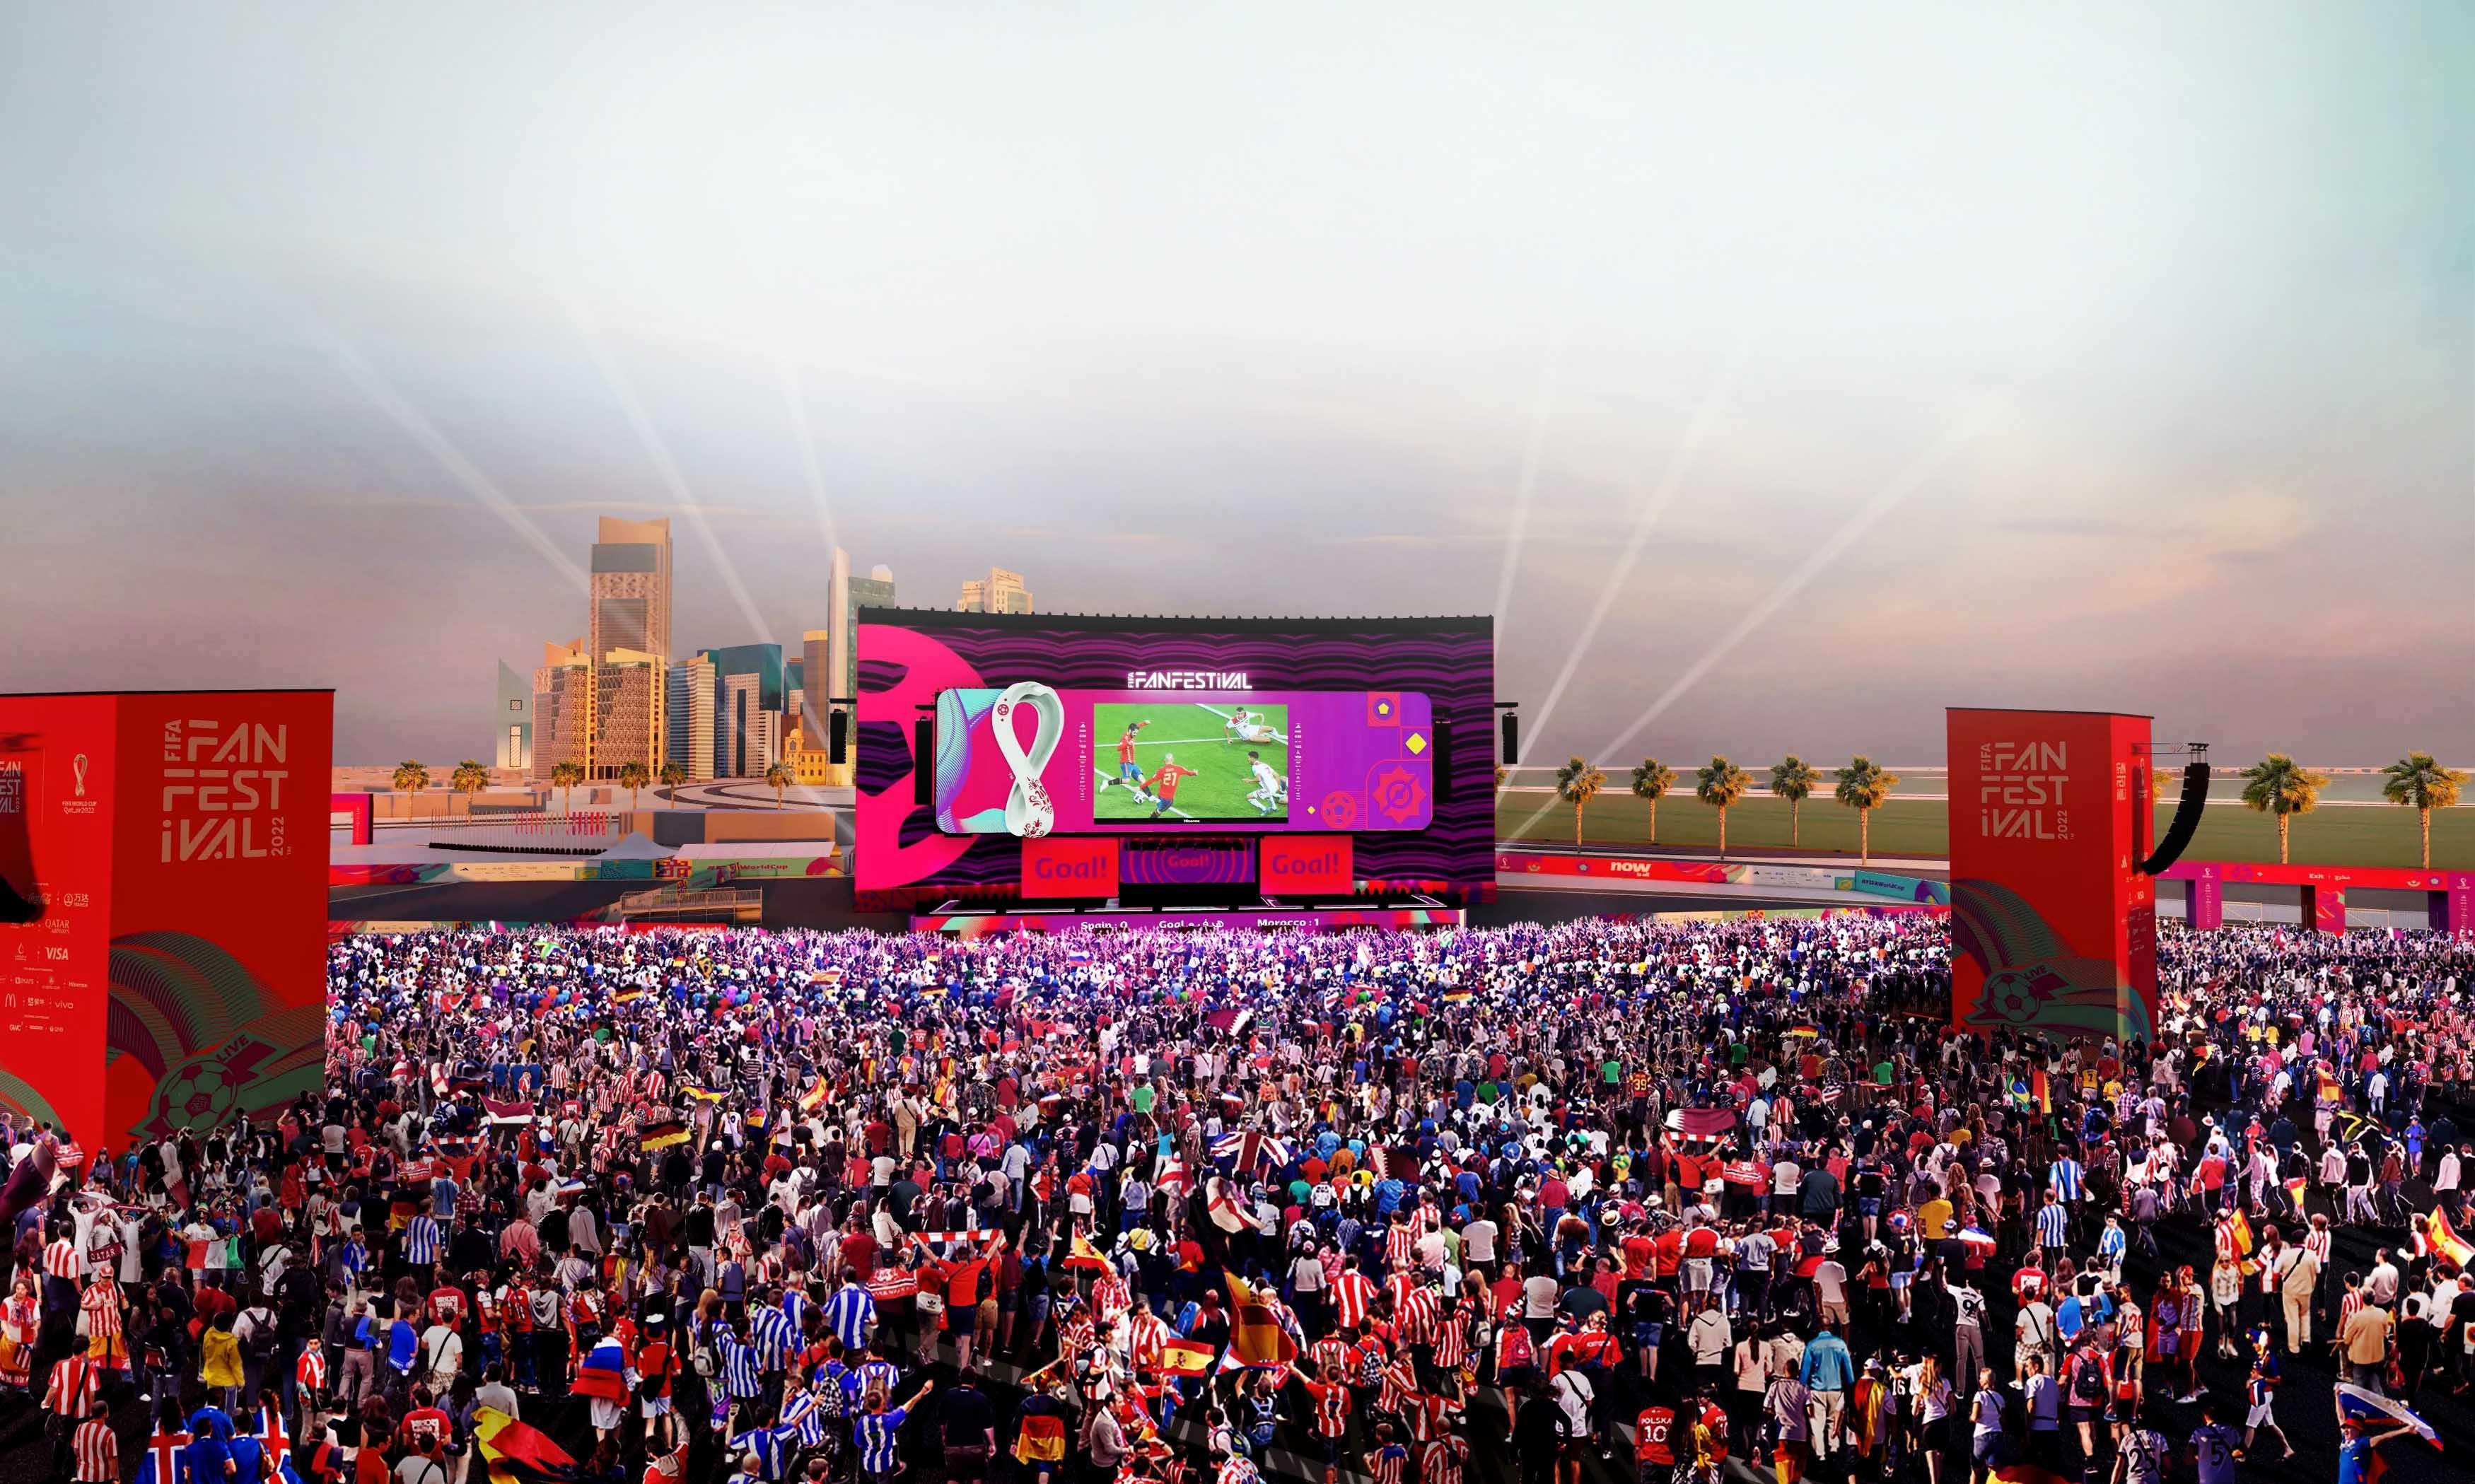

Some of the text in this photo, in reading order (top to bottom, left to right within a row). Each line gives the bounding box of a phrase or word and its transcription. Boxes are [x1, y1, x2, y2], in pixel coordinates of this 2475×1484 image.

[164, 719, 182, 761] FIFA
[187, 719, 287, 764] FAN
[1980, 742, 1991, 771] FIFA
[1994, 740, 2067, 771] FAN
[0, 779, 21, 795] EST
[163, 769, 289, 812] FEST
[1981, 775, 2069, 805] FEST
[2057, 810, 2068, 840] 2022
[271, 817, 284, 856] 2022
[1035, 855, 1107, 880] Goal!
[1167, 853, 1209, 869] Goal!
[1271, 852, 1340, 875] Goal!
[1610, 861, 1652, 872] now
[45, 918, 70, 929] QATAR
[1158, 920, 1184, 929] Goal
[1257, 918, 1307, 927] Morocco
[45, 946, 69, 961] VISA
[2024, 965, 2049, 980] LIVE
[54, 1000, 74, 1010] vivo
[216, 1034, 249, 1063] LIVE
[1633, 1078, 1647, 1090] 39
[91, 1247, 116, 1261] QATAR
[1892, 1379, 1906, 1396] 16
[1643, 1425, 1669, 1443] 10
